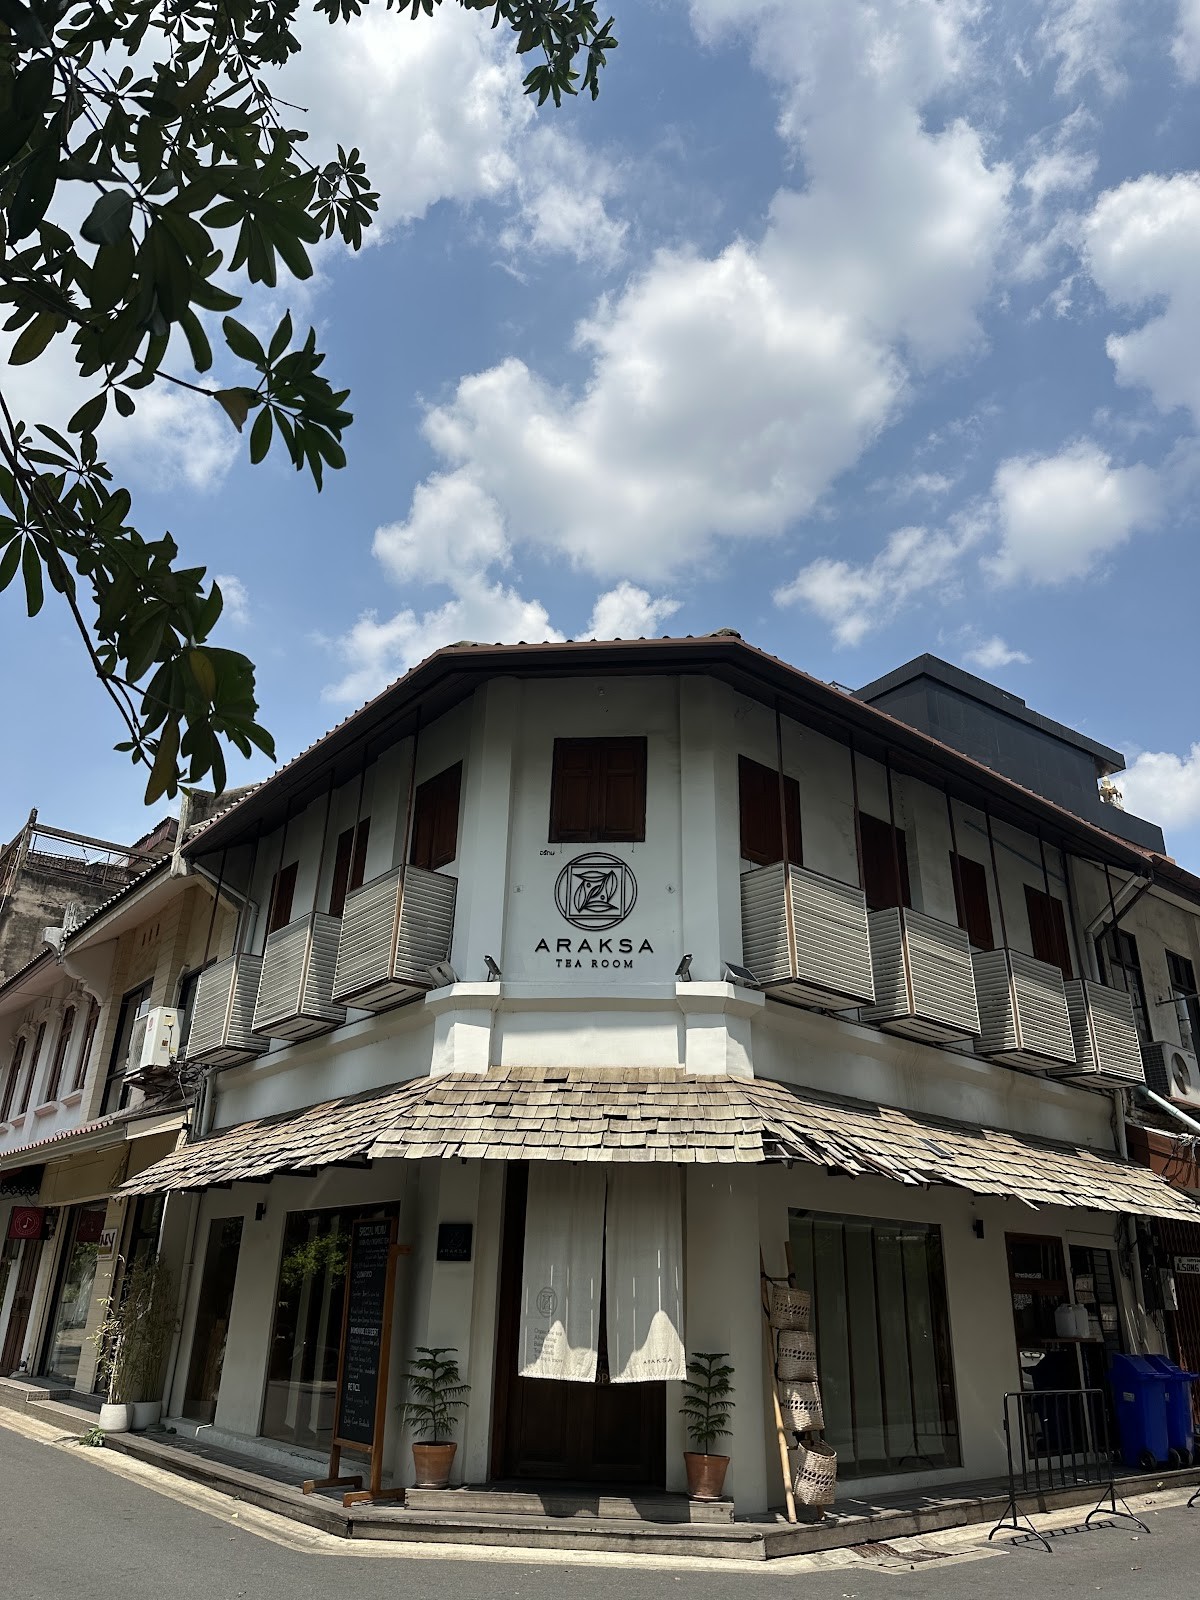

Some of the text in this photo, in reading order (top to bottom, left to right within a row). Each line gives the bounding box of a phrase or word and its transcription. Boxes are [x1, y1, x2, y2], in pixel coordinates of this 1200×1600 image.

[534, 938, 654, 954] ARAKSA
[556, 959, 633, 969] TEA ROOM
